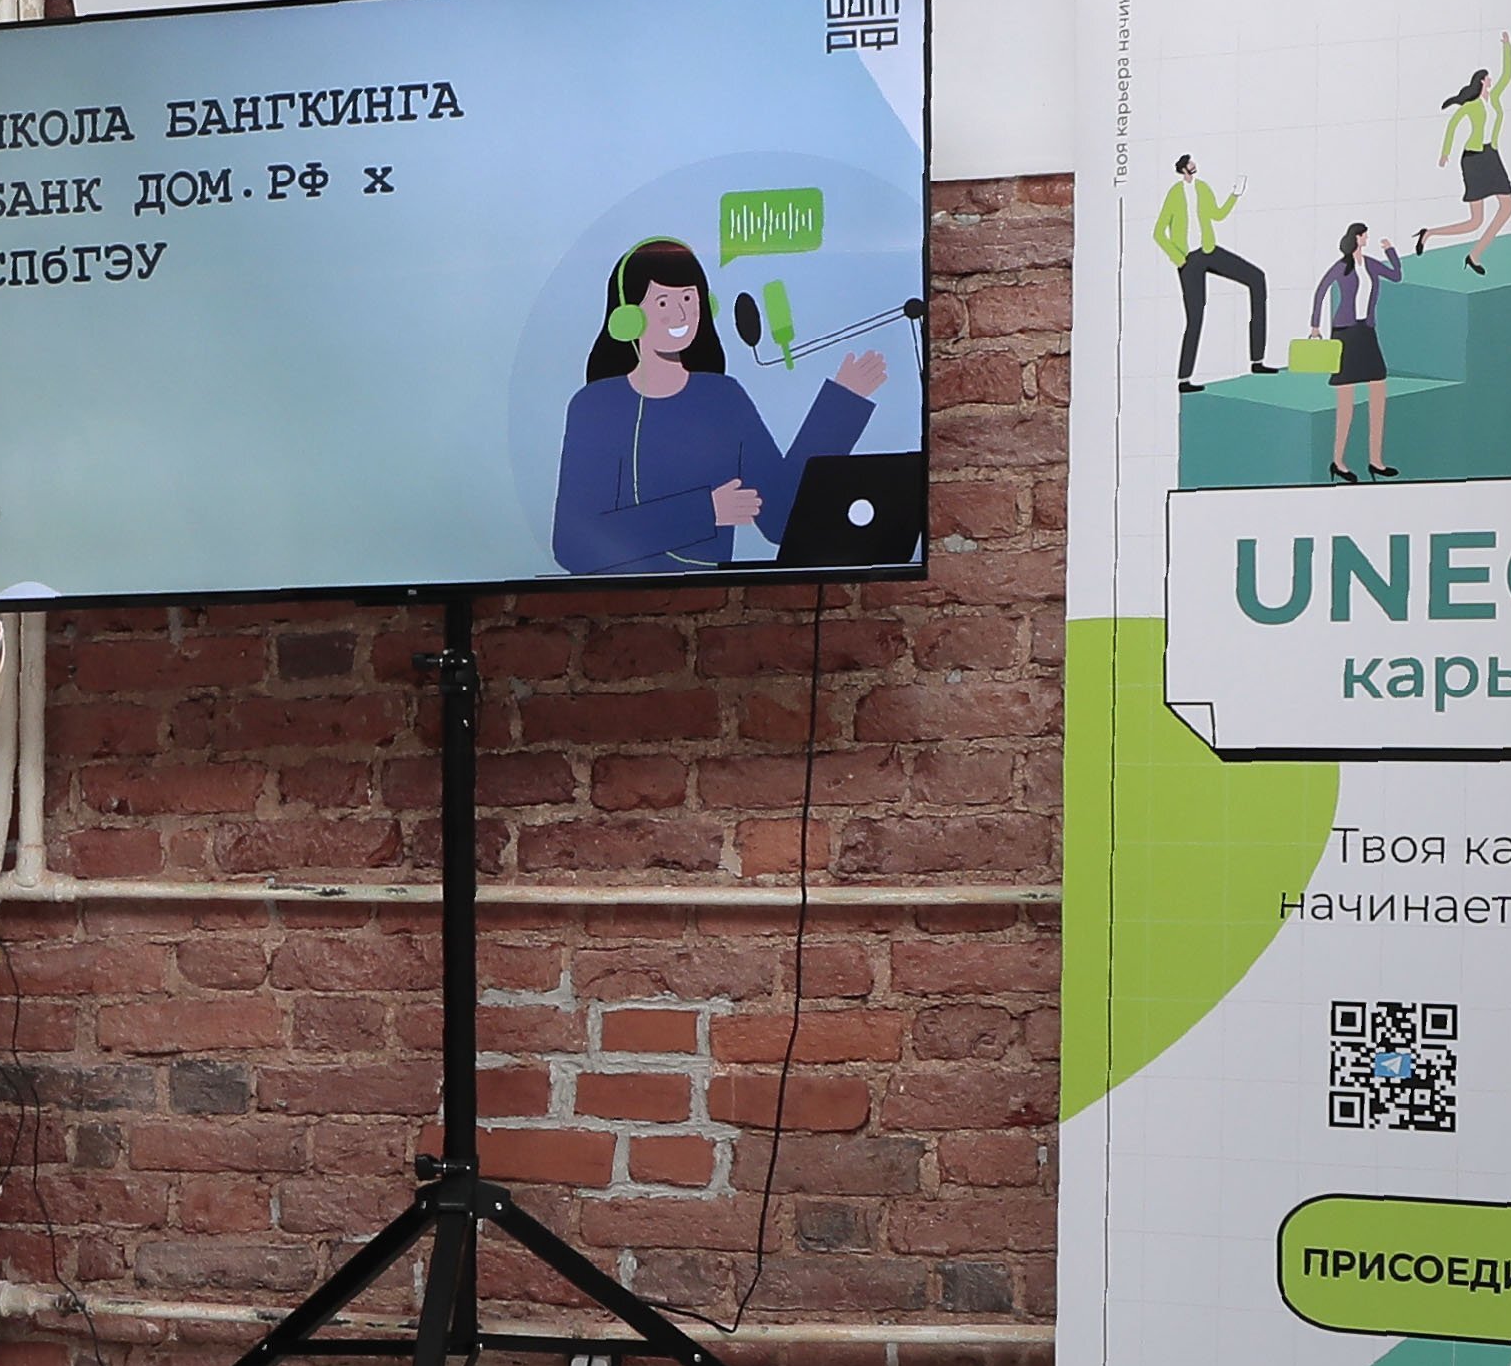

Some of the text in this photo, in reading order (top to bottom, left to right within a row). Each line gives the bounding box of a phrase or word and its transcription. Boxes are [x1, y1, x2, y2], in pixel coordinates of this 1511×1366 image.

[825, 26, 899, 55] РФ
[165, 81, 465, 138] БАНГКИНГА
[1117, 57, 1132, 136] карьера
[135, 161, 330, 217] ДОМ.РФ
[1114, 143, 1128, 187] Твоя
[1332, 827, 1446, 865] Твоя
